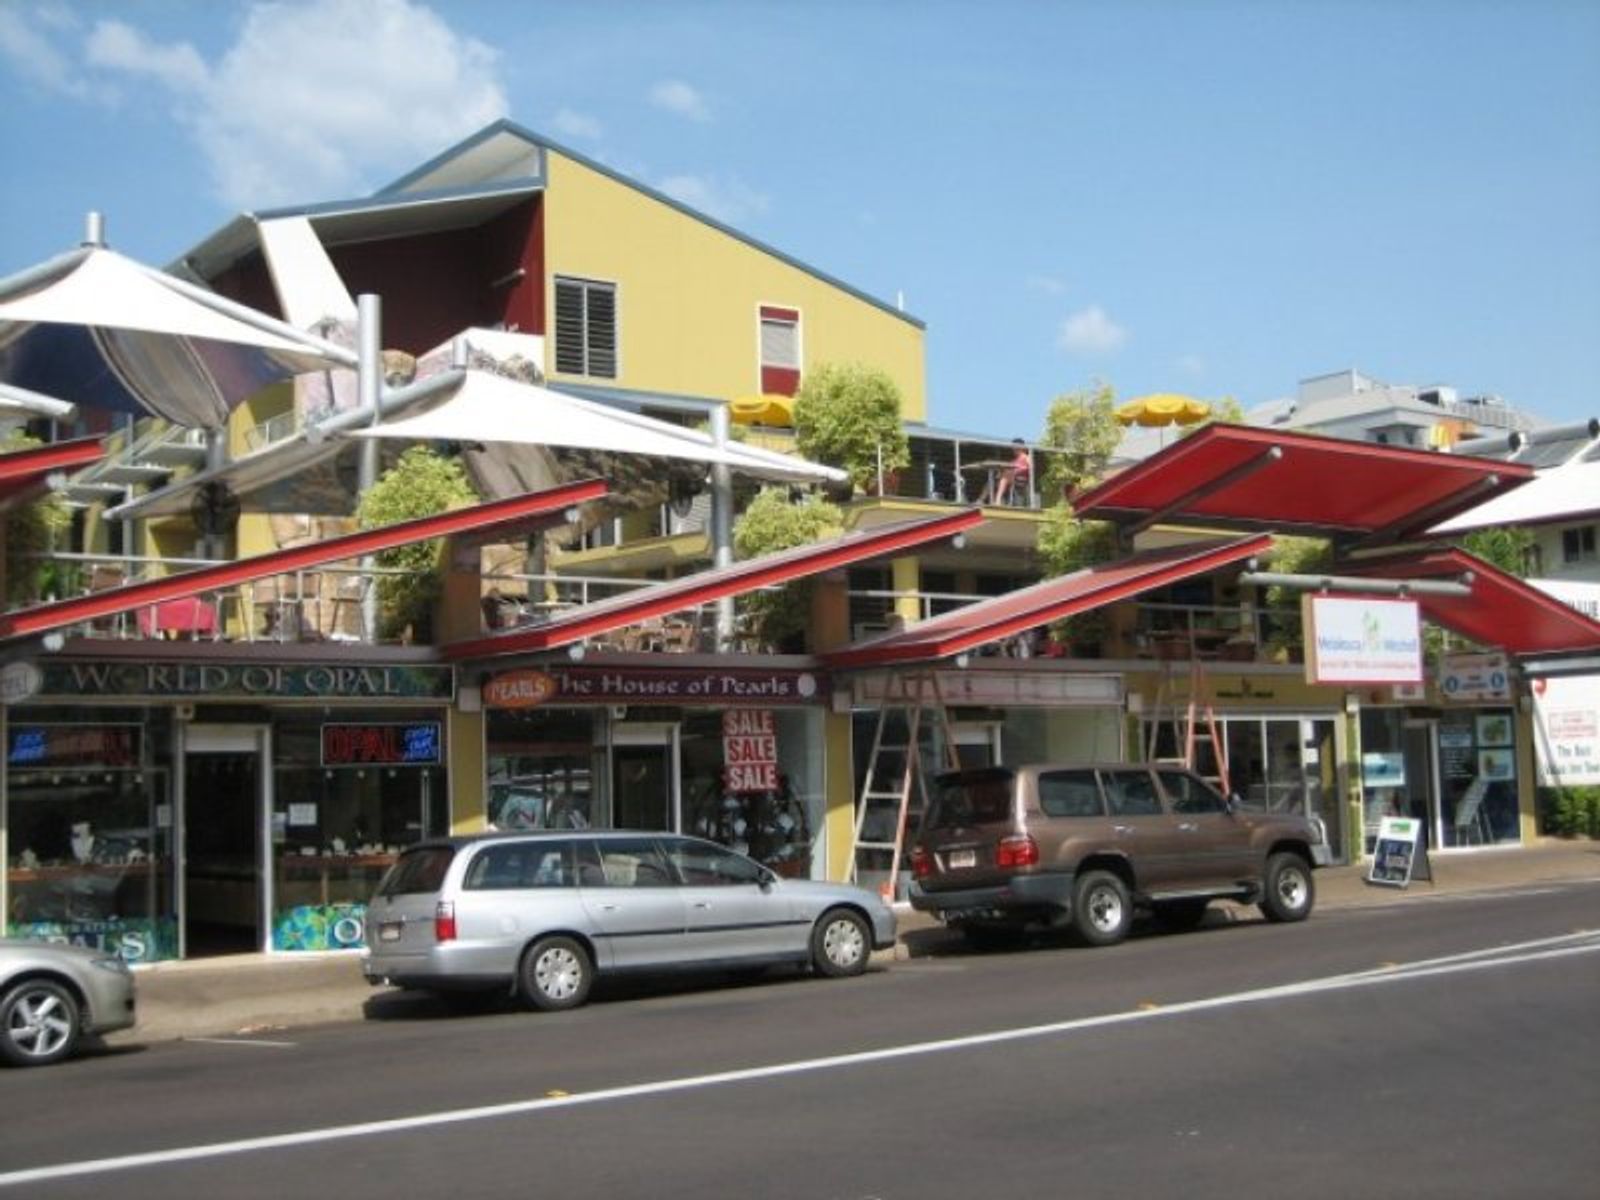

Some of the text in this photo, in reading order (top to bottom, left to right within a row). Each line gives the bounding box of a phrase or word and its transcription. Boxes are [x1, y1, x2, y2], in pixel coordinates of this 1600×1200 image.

[71, 664, 400, 694] WORLD OF OPAL
[602, 674, 679, 695] House
[688, 676, 715, 695] of
[720, 676, 789, 696] Pearls
[723, 710, 773, 736] SALE
[728, 736, 775, 761] SALE
[729, 765, 777, 790] SALE
